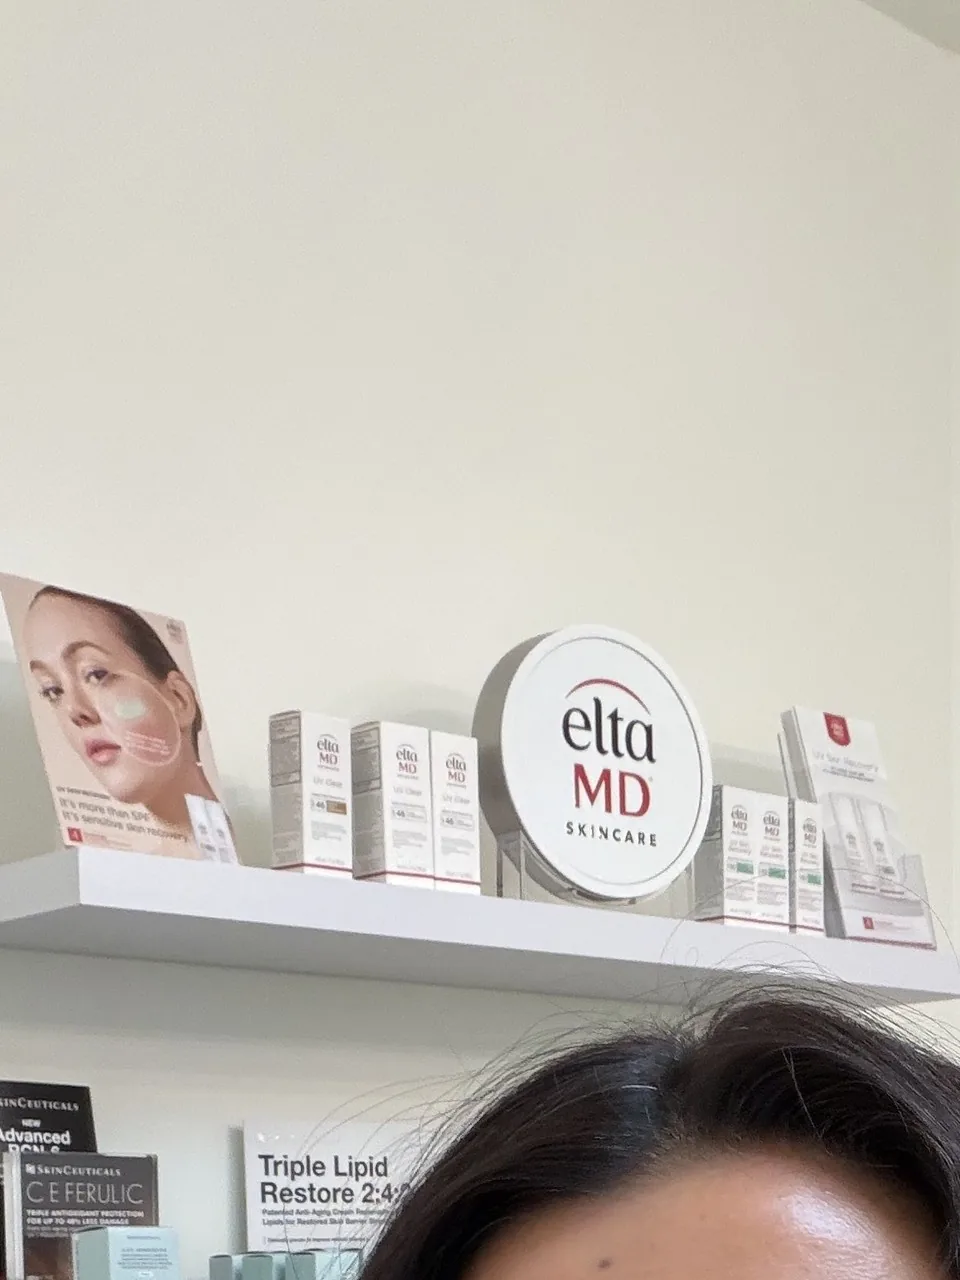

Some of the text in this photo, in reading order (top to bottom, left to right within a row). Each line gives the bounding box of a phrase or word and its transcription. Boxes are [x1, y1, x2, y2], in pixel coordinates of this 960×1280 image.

[562, 696, 656, 764] elta
[317, 737, 339, 753] elta
[319, 753, 338, 765] MD
[396, 748, 418, 762] elta
[445, 756, 467, 771] elta
[398, 762, 417, 774] MD
[448, 771, 466, 783] MD
[574, 763, 651, 817] MD
[78, 801, 105, 815] more
[107, 805, 130, 819] than
[81, 814, 124, 831] sensitive
[126, 822, 148, 835] skin
[147, 827, 188, 843] recovery
[566, 821, 657, 847] SKINCARE
[22, 1119, 41, 1127] NEW
[258, 1154, 388, 1182] Triple Lipid
[26, 1181, 144, 1205] C E FERULIC
[261, 1181, 354, 1204] Restore
[51, 1209, 99, 1217] ANTIOXIDANT
[101, 1210, 144, 1218] PROTECTION
